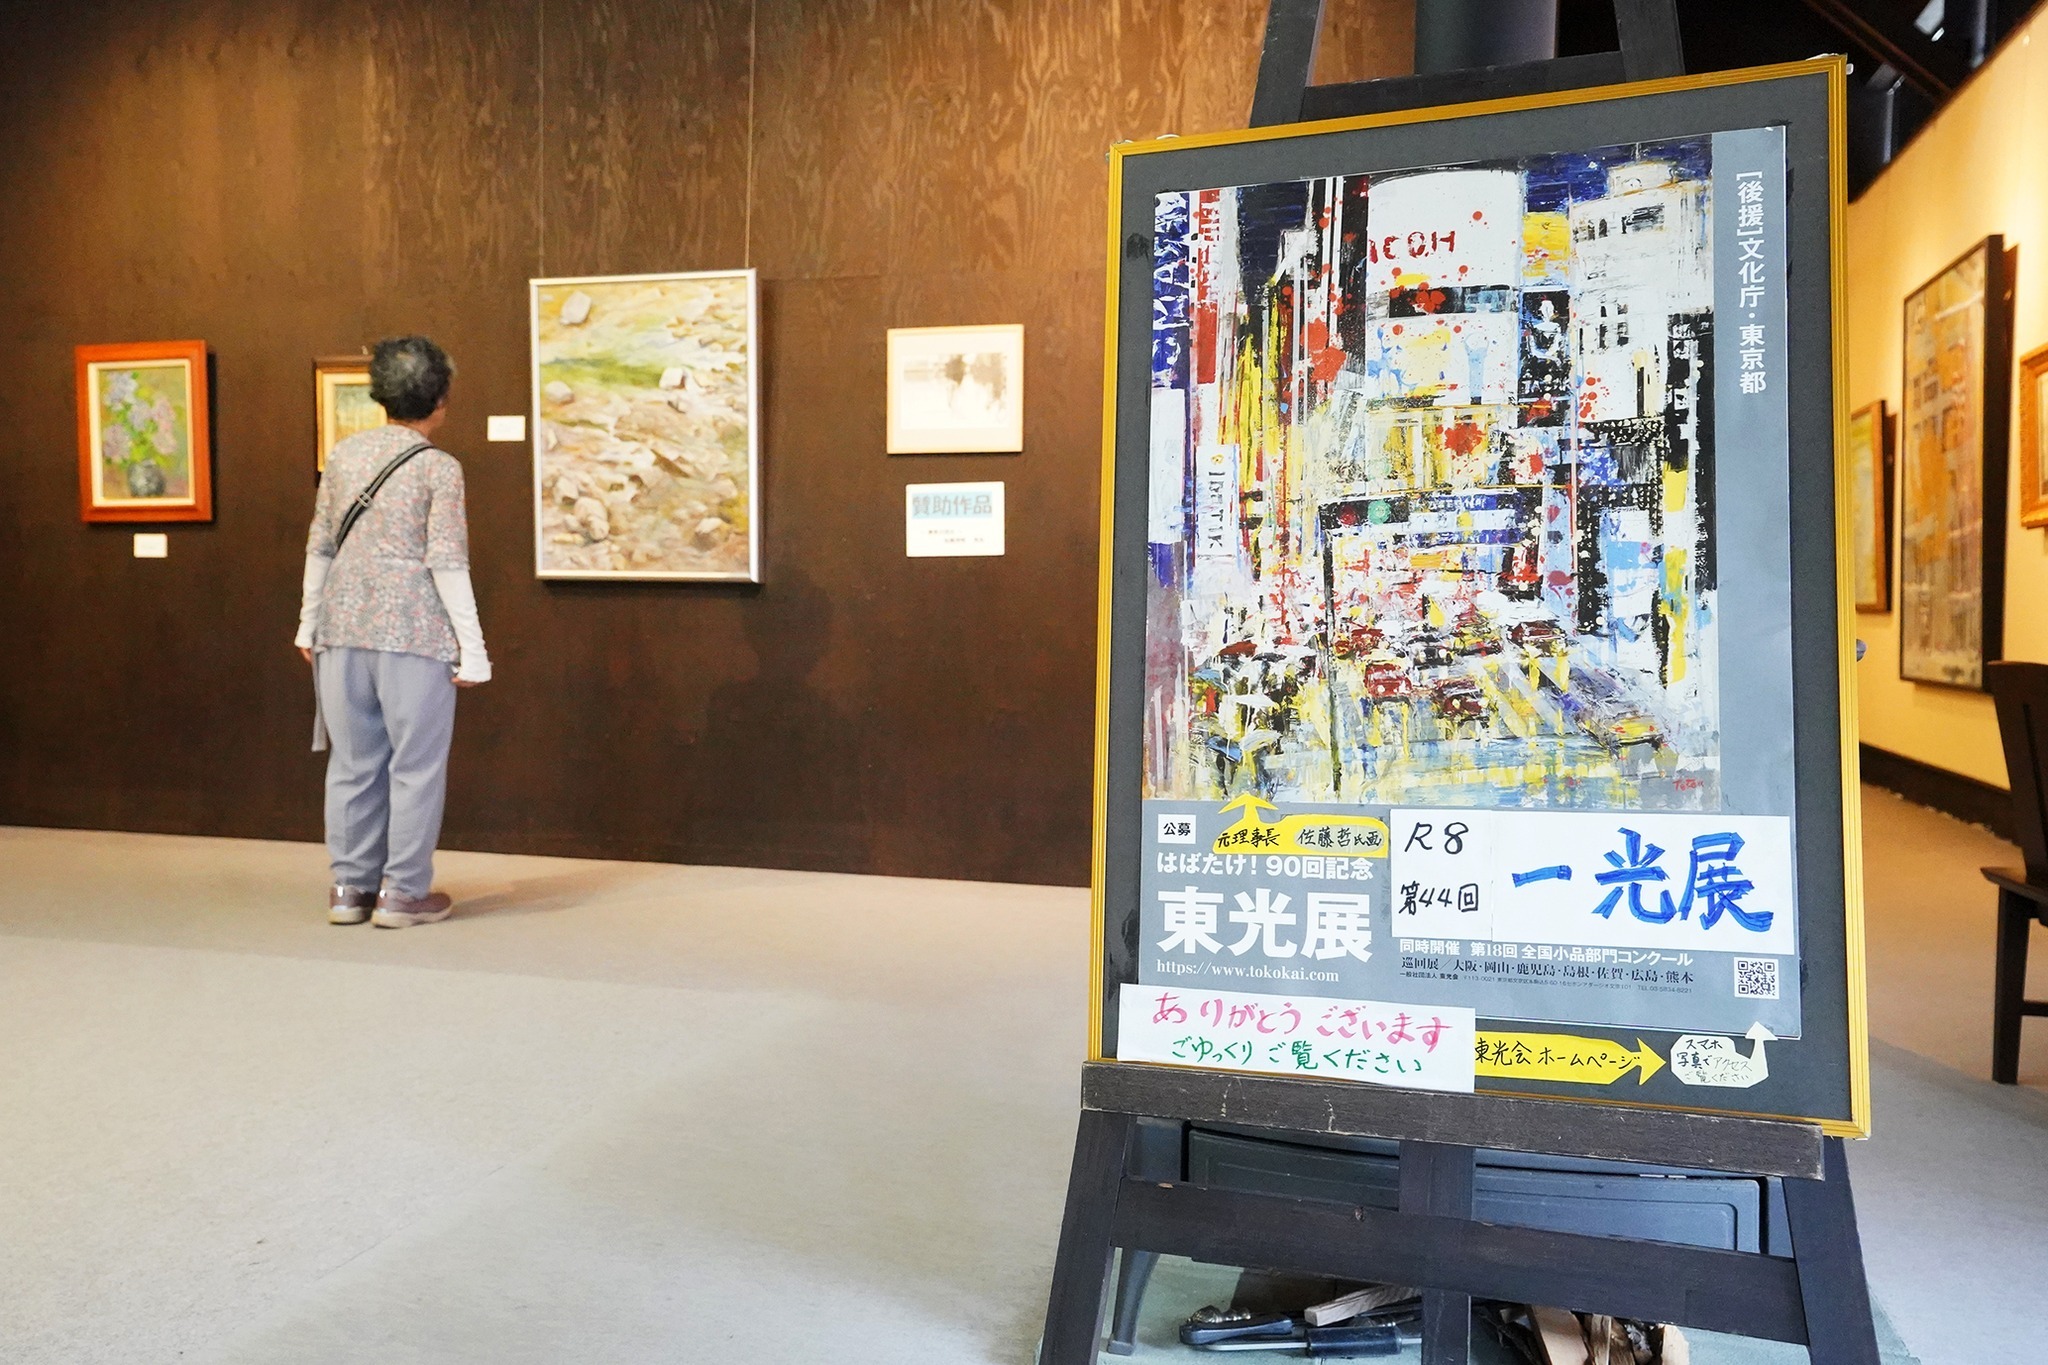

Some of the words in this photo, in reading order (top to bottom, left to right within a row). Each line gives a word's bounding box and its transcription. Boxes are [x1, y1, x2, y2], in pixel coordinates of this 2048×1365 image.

[1163, 821, 1192, 838] 公募
[1217, 826, 1281, 849] 元理事長
[1511, 826, 1775, 933] 一光展
[1398, 880, 1480, 916] 第44回
[1156, 885, 1374, 963] 東光展
[1400, 938, 1460, 956] 同時開催
[1470, 941, 1518, 959] 第18回
[1521, 944, 1694, 967] 全国小品部門コンクール
[1156, 959, 1339, 983] https://www.tokokai.com
[1152, 992, 1301, 1035] ありがとう
[1316, 1005, 1453, 1054] ございます
[1171, 1036, 1253, 1066] ごゆっくり
[1269, 1040, 1422, 1074] ご覧ください
[1475, 1037, 1532, 1067] 東光会
[1537, 1047, 1641, 1070] ホームページ
[1685, 1038, 1723, 1050] スマホ
